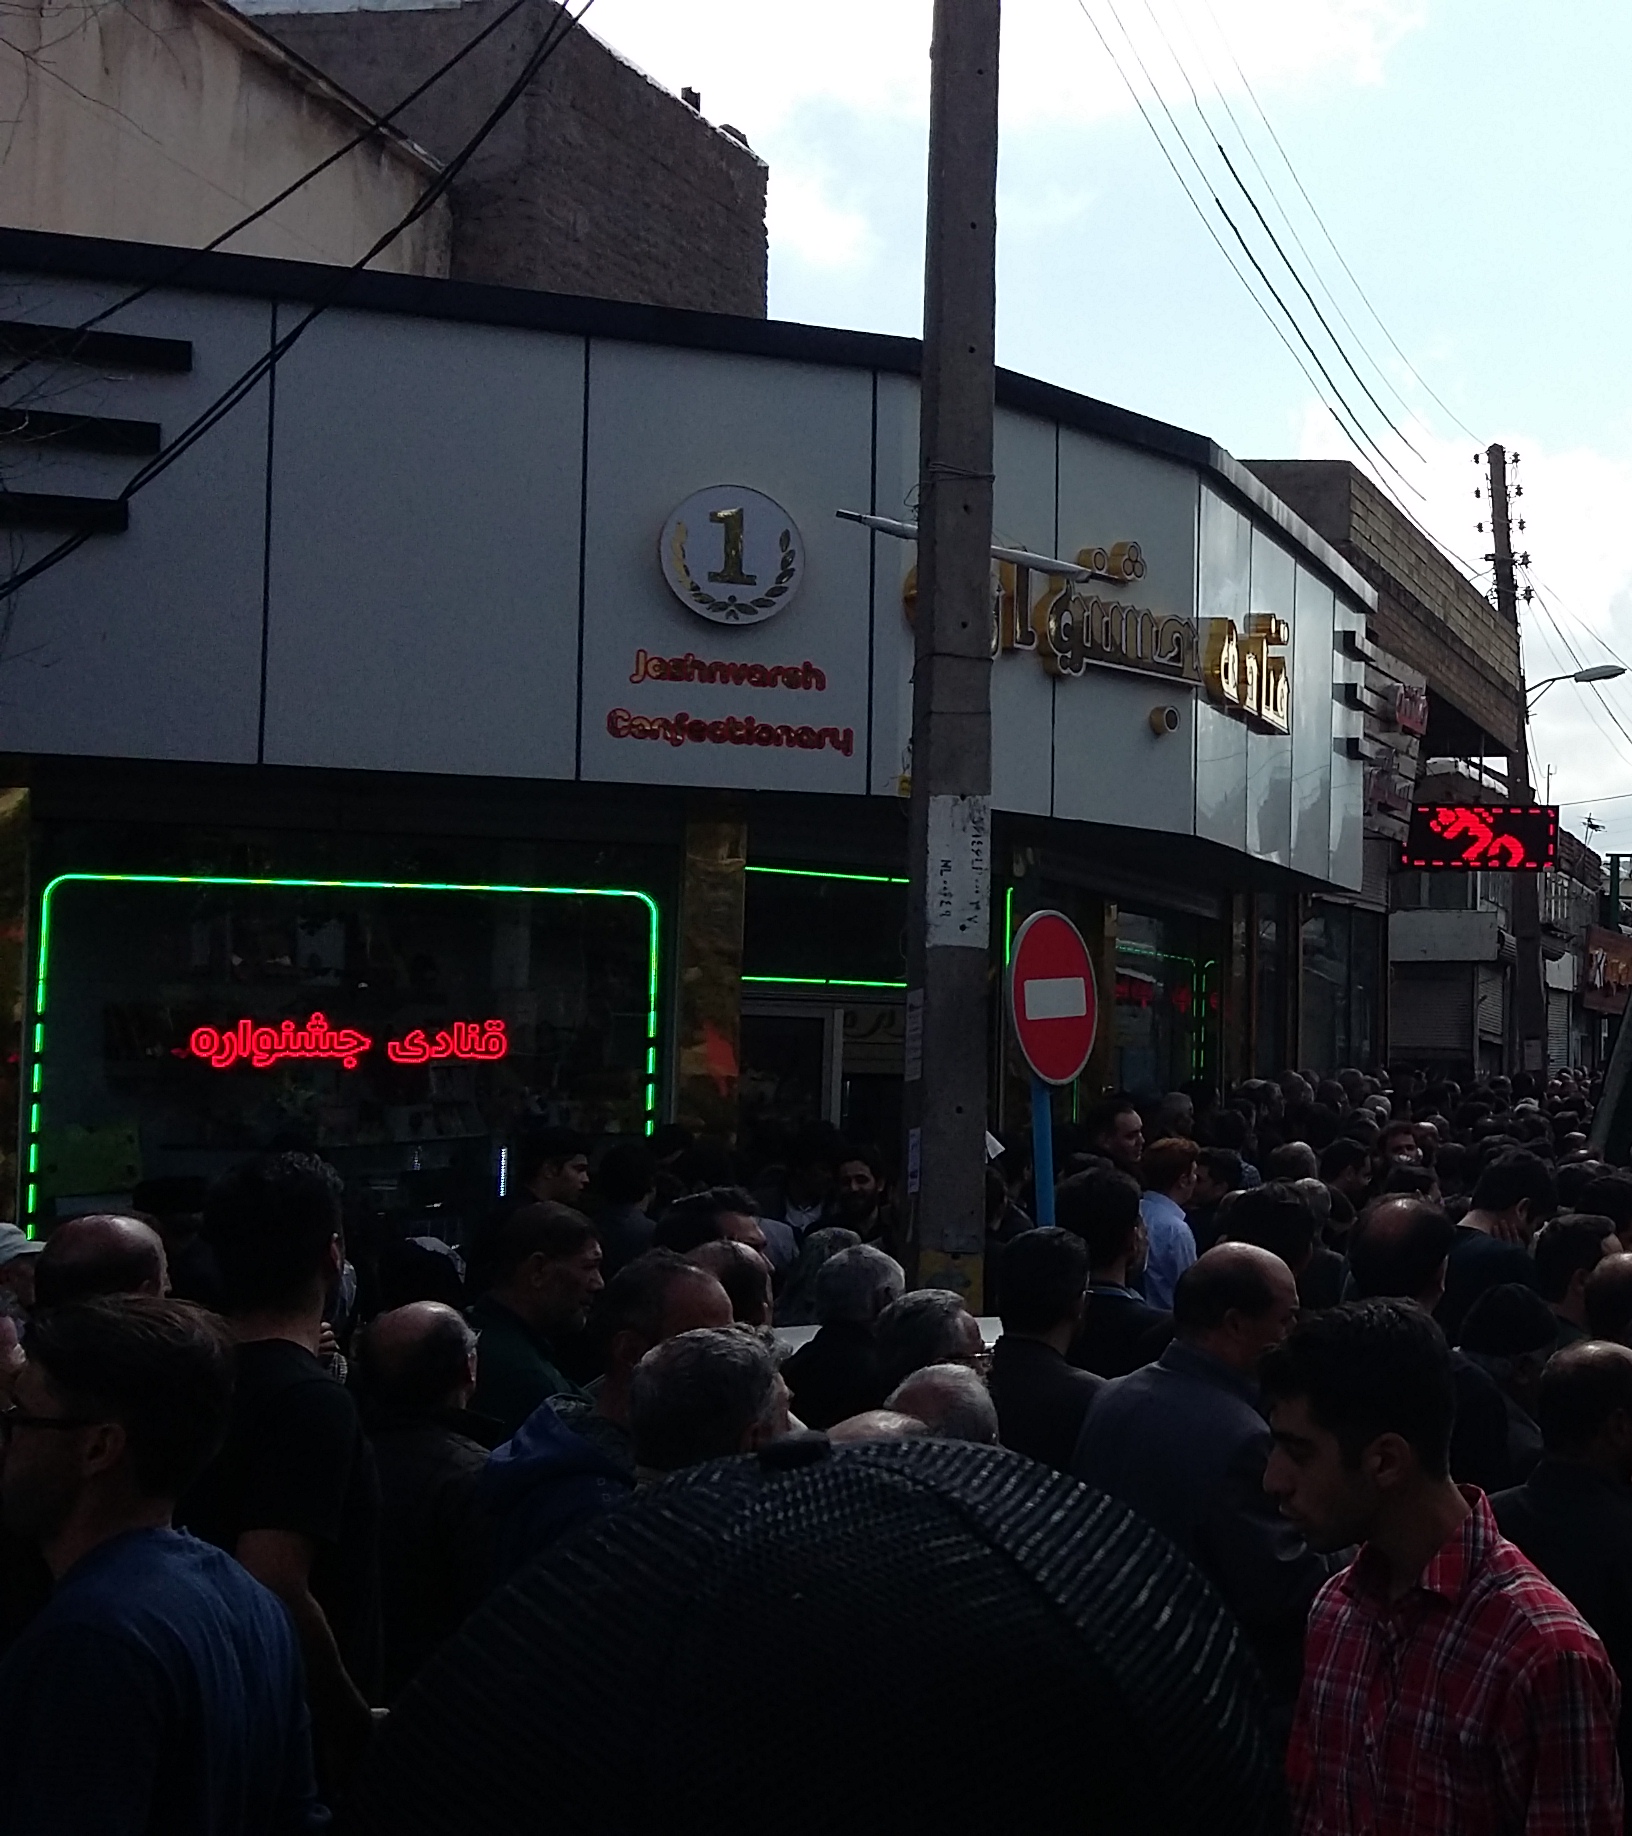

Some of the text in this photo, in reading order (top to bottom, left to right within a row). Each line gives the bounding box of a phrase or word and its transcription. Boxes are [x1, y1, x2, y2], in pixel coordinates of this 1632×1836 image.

[707, 506, 757, 586] 1
[607, 708, 853, 757] Confectionary
[187, 1012, 508, 1069] قنادی جشنواره
